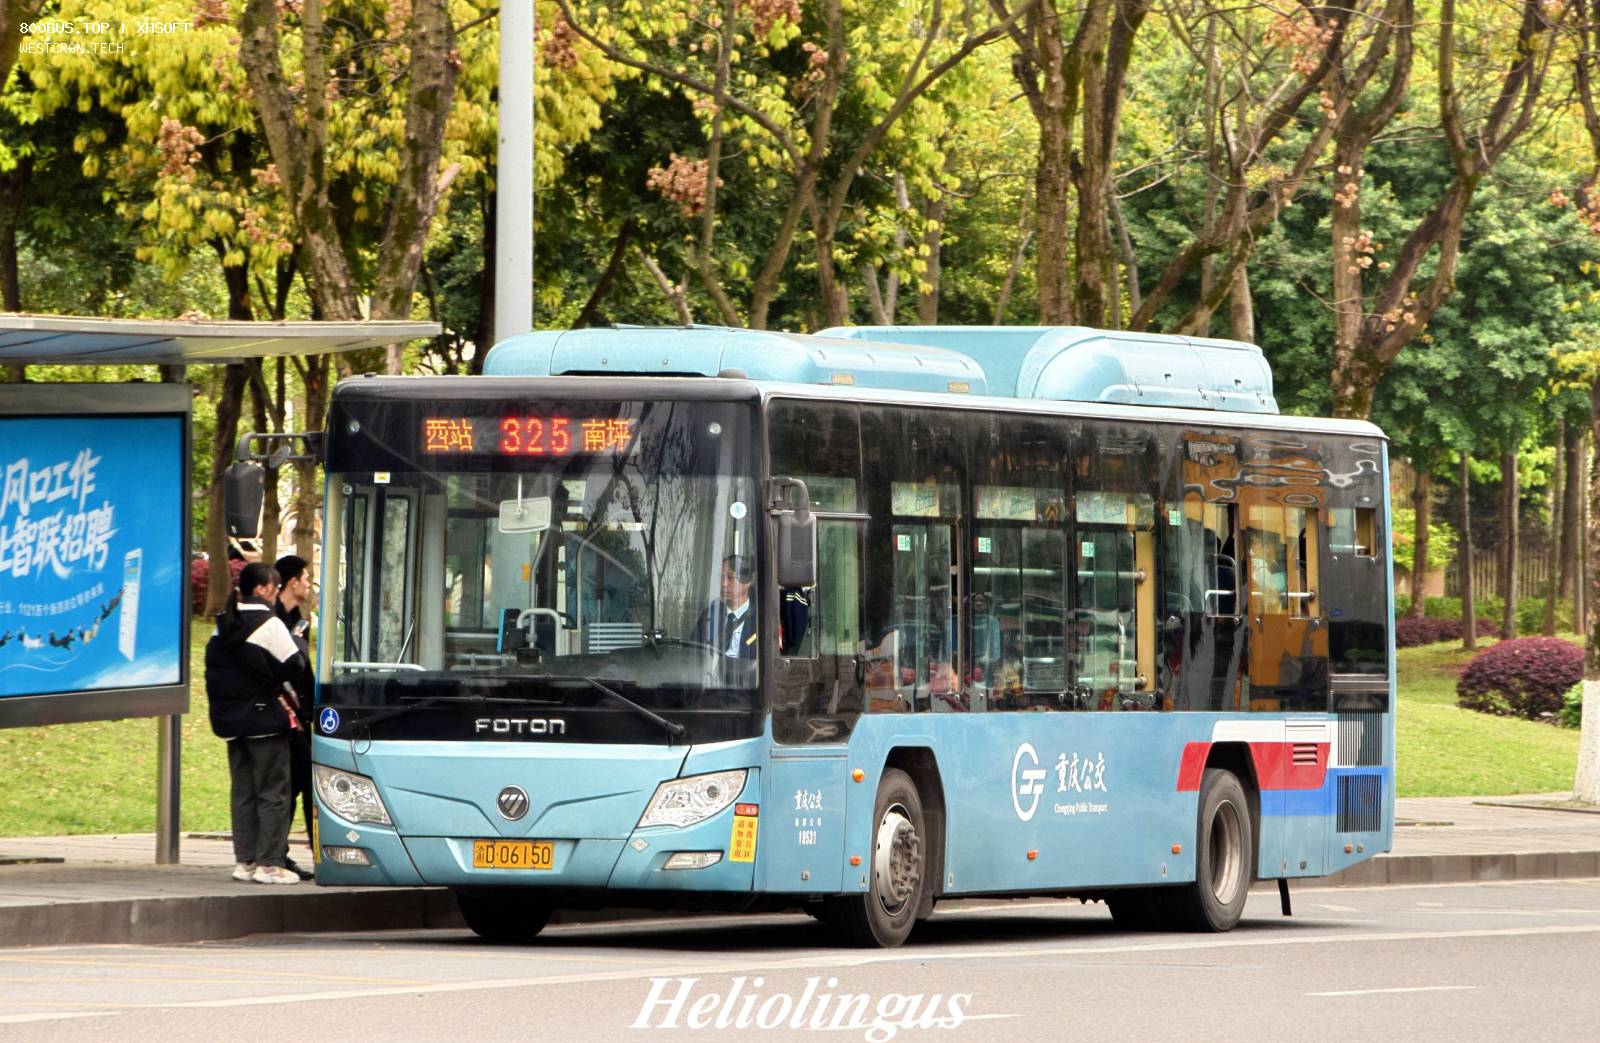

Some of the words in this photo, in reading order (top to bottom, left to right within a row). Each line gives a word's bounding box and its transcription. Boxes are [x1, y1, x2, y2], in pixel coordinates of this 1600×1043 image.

[426, 418, 473, 451] 西站
[503, 417, 569, 453] 325
[582, 418, 632, 451] 南坪
[0, 448, 102, 518] 风口工作
[475, 718, 566, 734] FOTON
